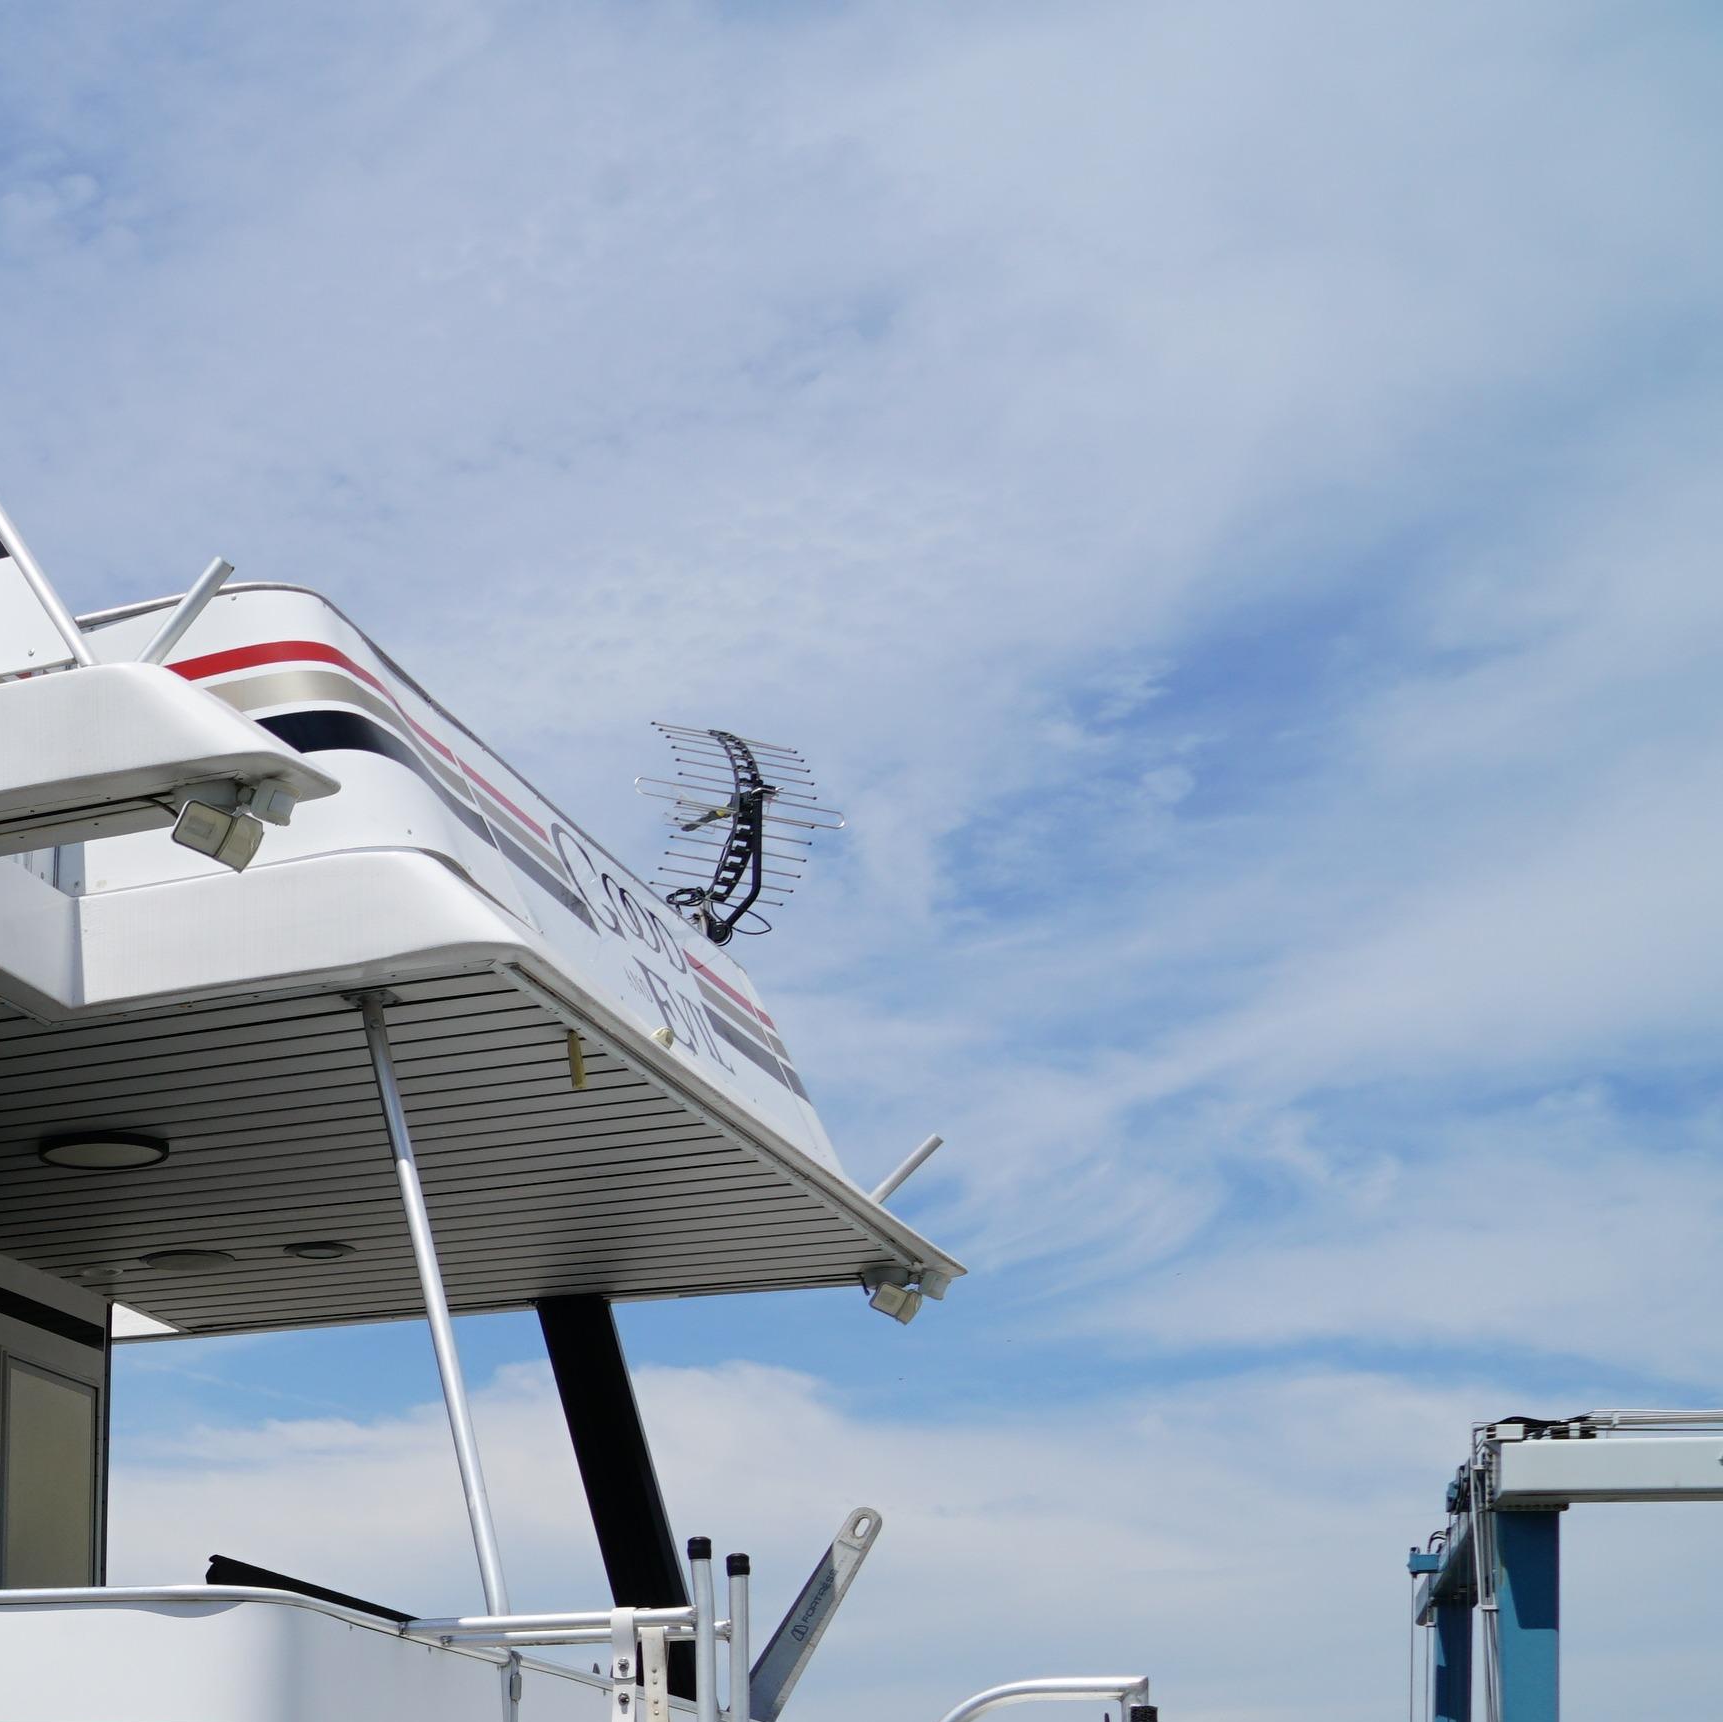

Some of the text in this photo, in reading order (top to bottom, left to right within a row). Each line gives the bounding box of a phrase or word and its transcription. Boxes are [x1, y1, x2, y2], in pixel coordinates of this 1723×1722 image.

[551, 822, 687, 974] GOOD
[631, 954, 736, 1076] EVIL
[801, 1568, 839, 1624] FORTRESS
